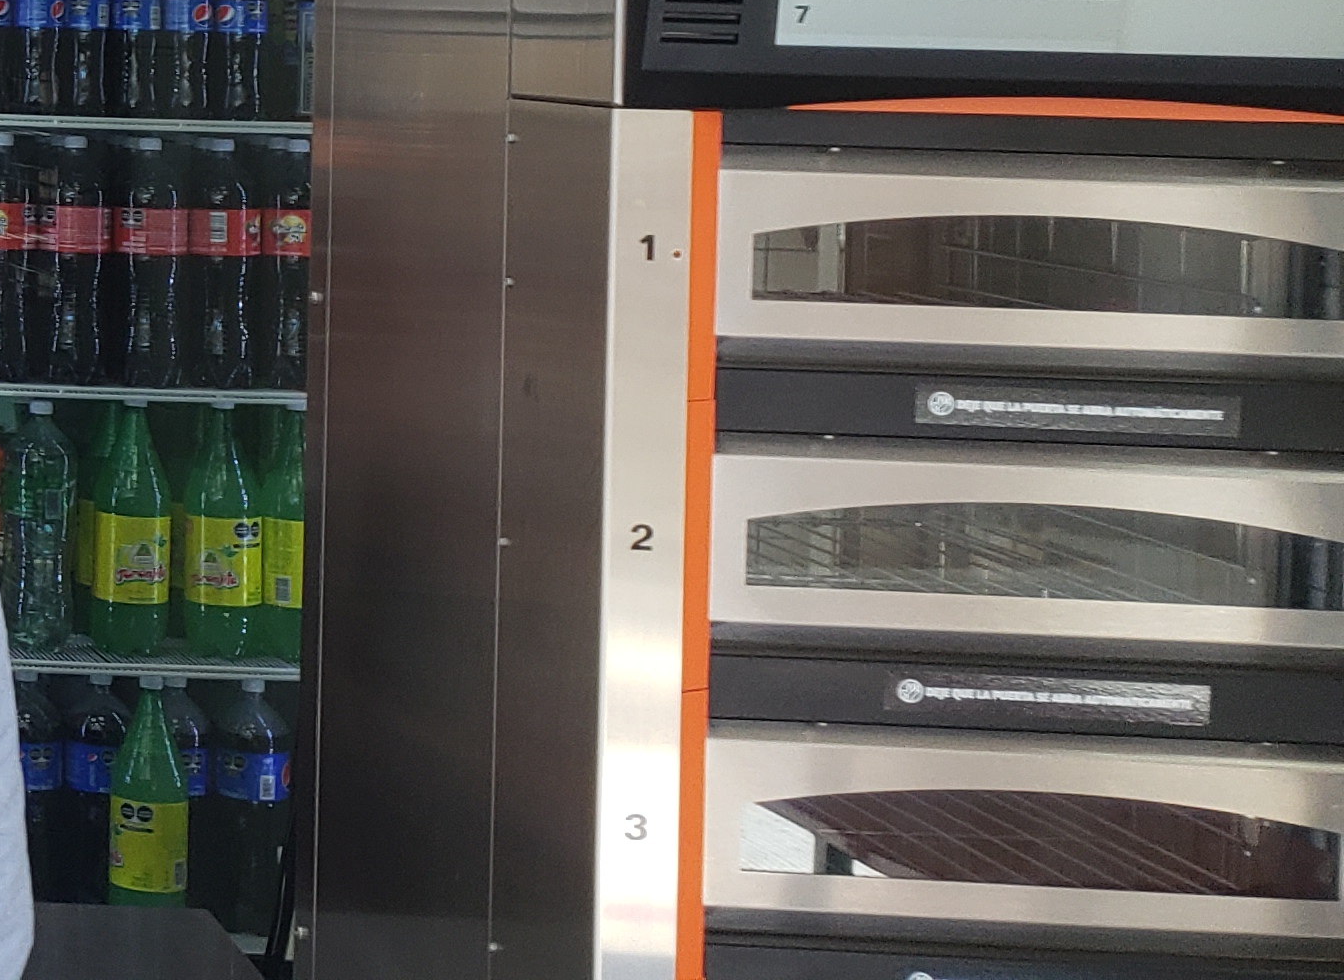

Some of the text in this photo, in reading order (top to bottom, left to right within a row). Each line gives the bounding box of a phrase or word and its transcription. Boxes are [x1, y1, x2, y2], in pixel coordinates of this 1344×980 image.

[793, 6, 810, 24] 7
[639, 234, 656, 261] 1
[630, 524, 654, 551] 2
[625, 813, 648, 841] 3
